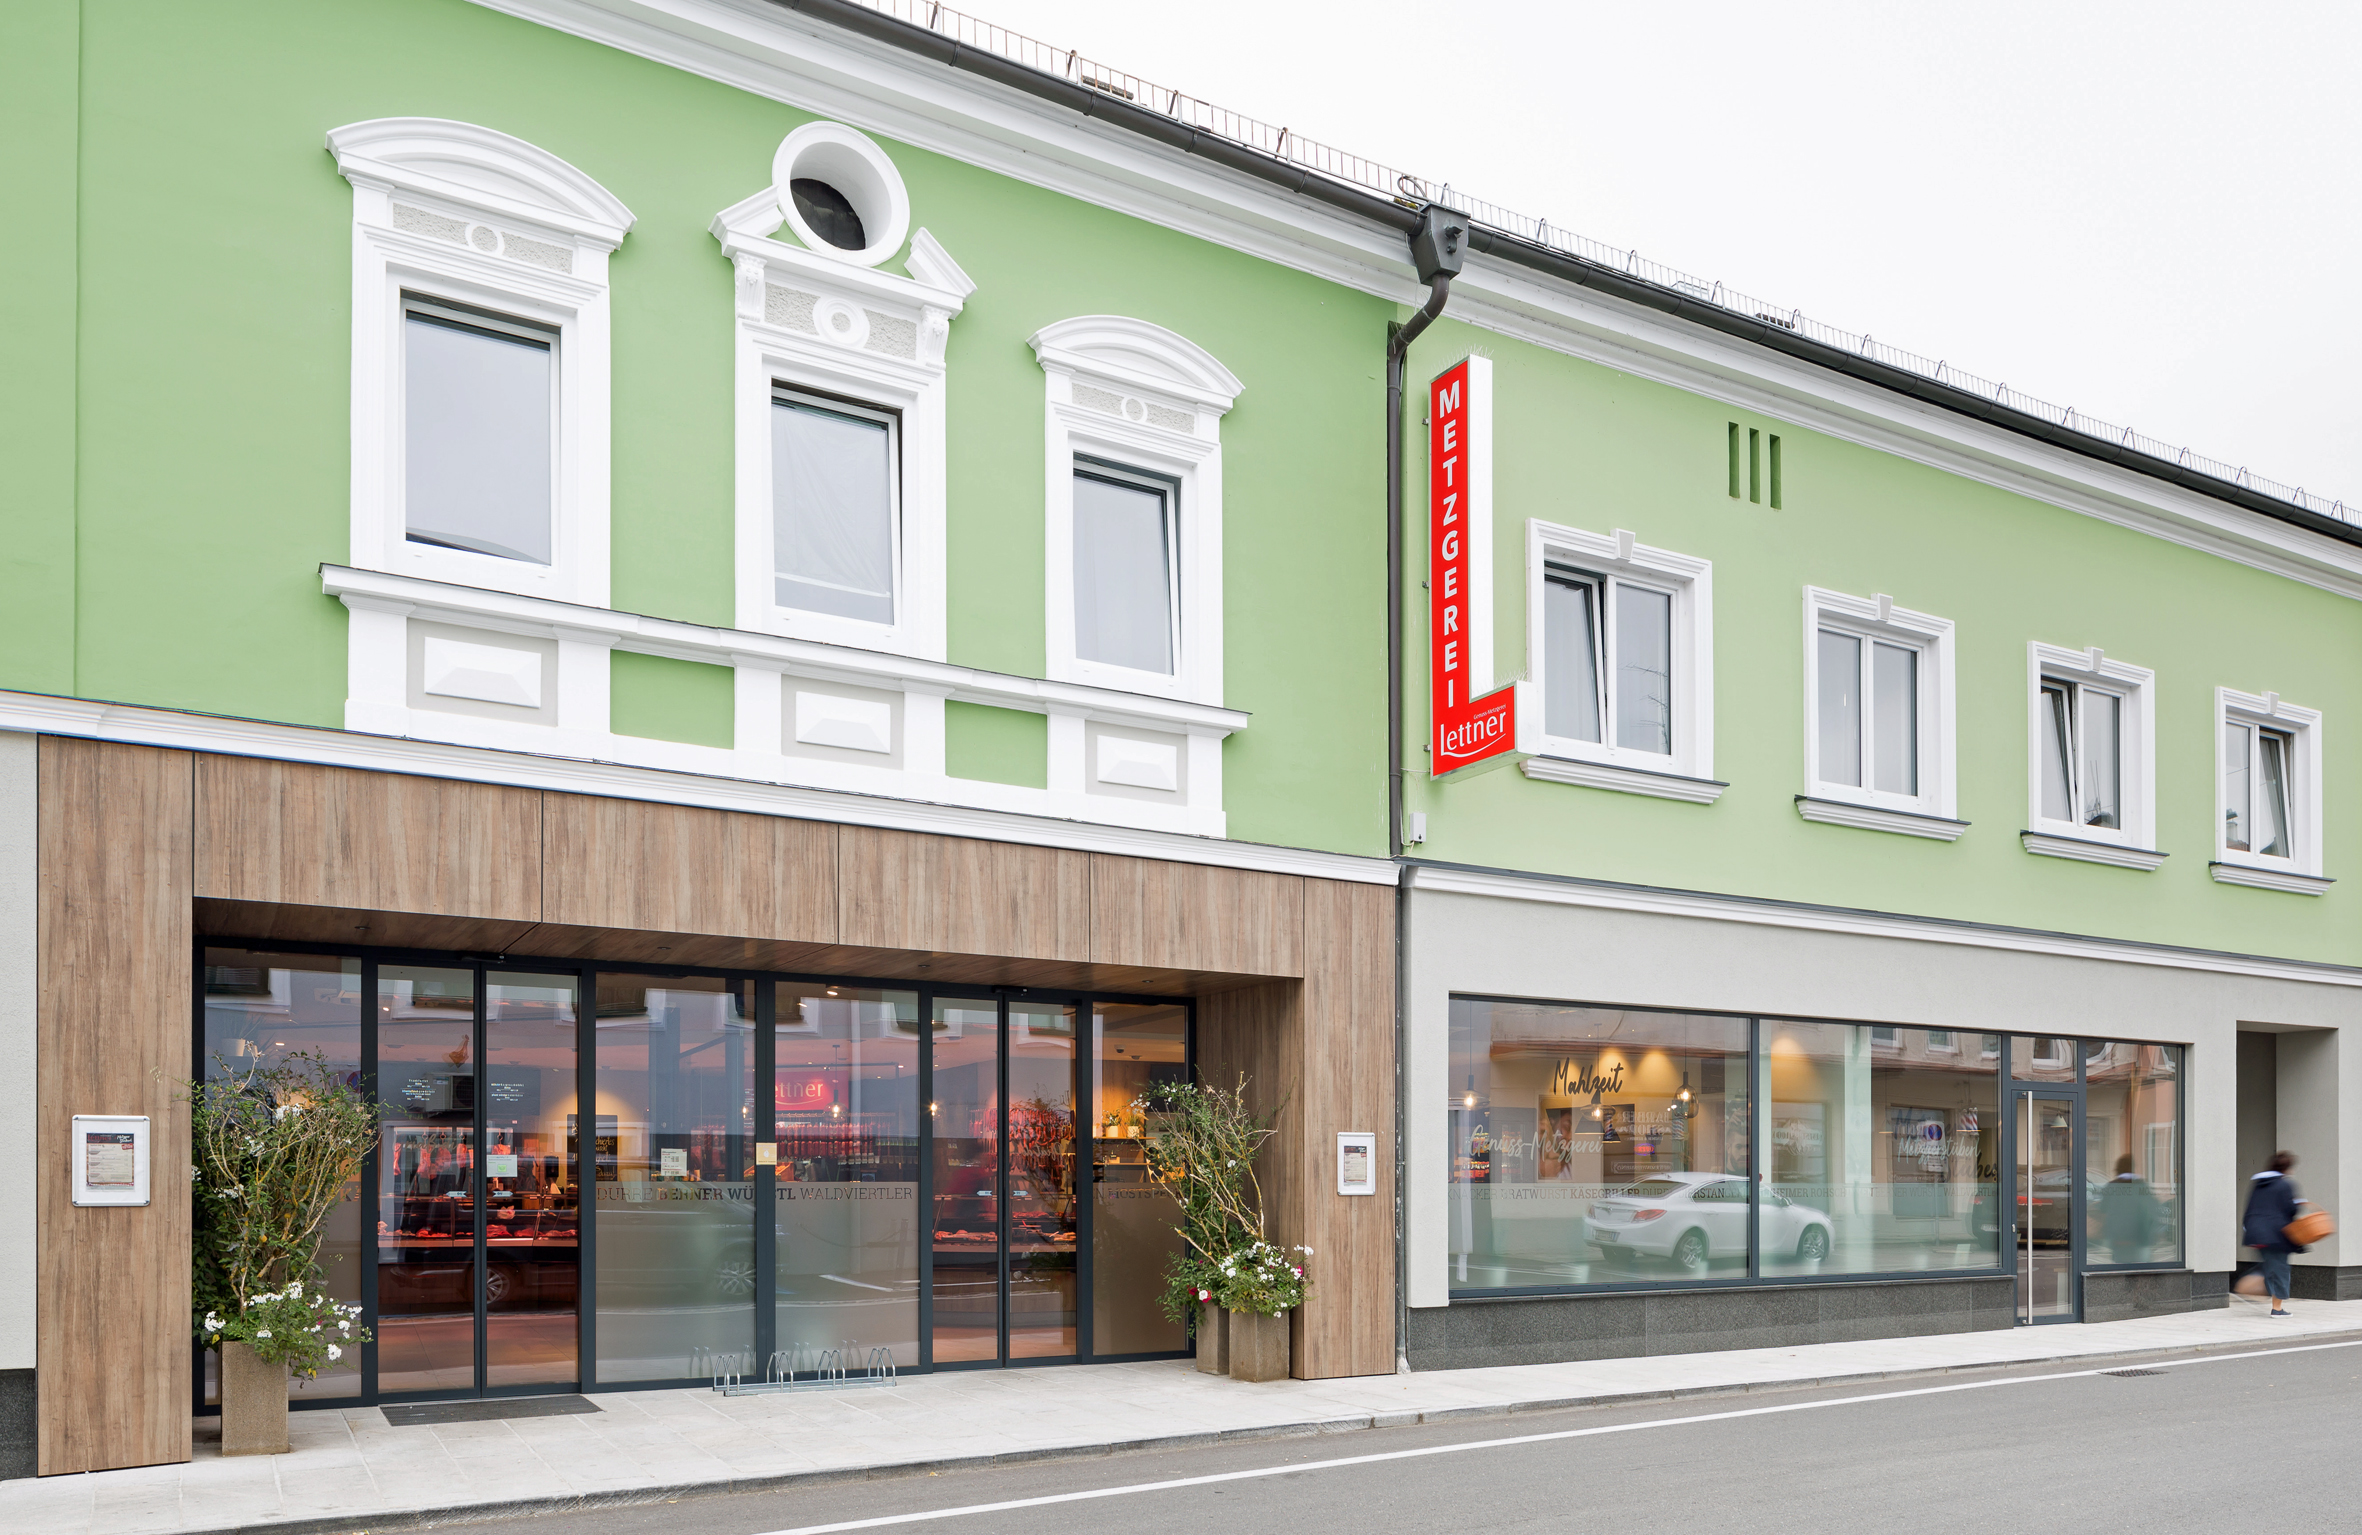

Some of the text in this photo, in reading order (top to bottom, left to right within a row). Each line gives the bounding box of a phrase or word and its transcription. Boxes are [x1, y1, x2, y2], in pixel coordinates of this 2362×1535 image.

[1439, 379, 1460, 708] METZGEREI
[1553, 1057, 1624, 1096] Mahlzeit
[1469, 1124, 1605, 1162] Genuss-Metzgerei
[597, 1185, 653, 1200] DÜRRE
[656, 1188, 723, 1200] BERNER
[800, 1188, 913, 1200] WALDVIERTLER
[1500, 1188, 1568, 1200] BRATWURST
